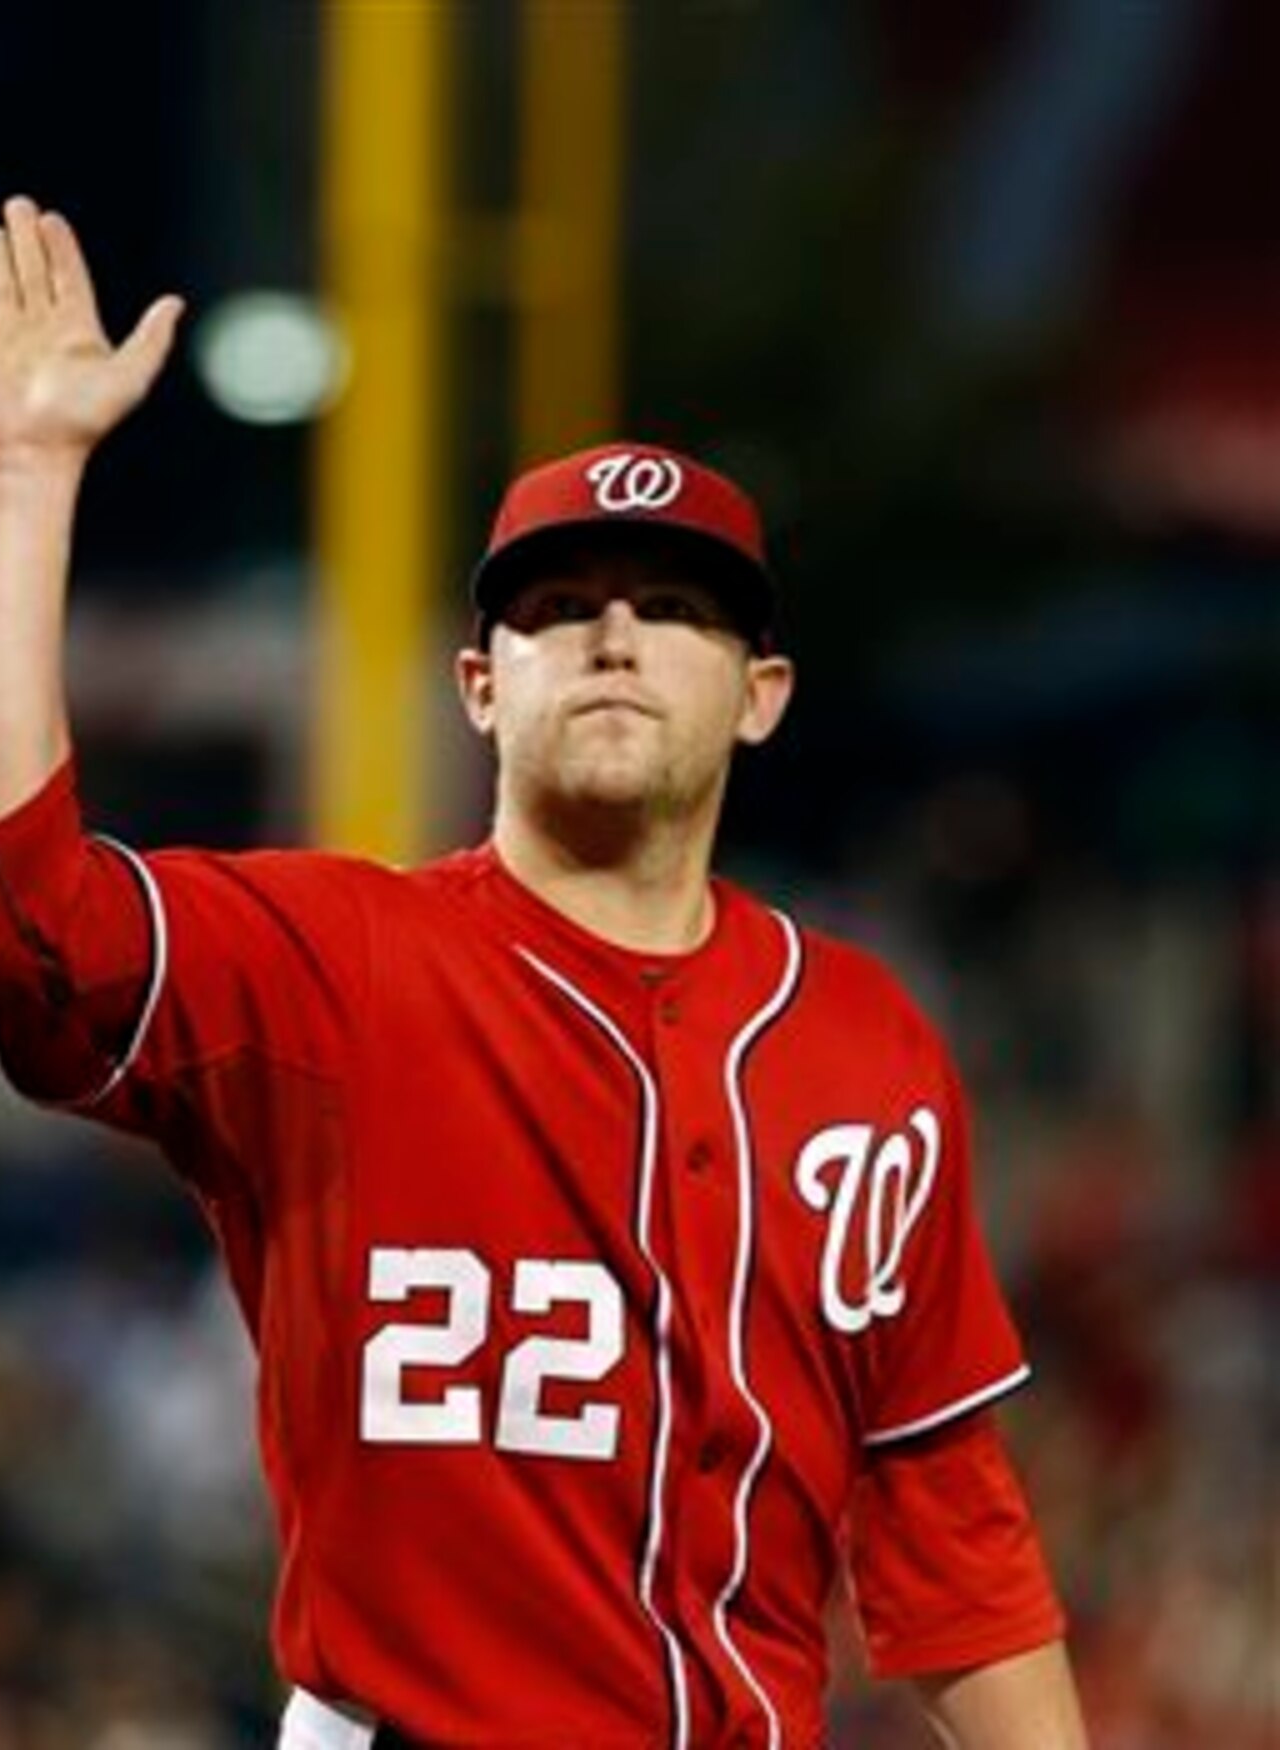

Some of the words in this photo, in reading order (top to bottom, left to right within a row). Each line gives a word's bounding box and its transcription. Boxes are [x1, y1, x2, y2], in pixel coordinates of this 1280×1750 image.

[586, 453, 682, 512] W
[795, 1107, 940, 1333] W
[359, 1247, 623, 1460] 22
